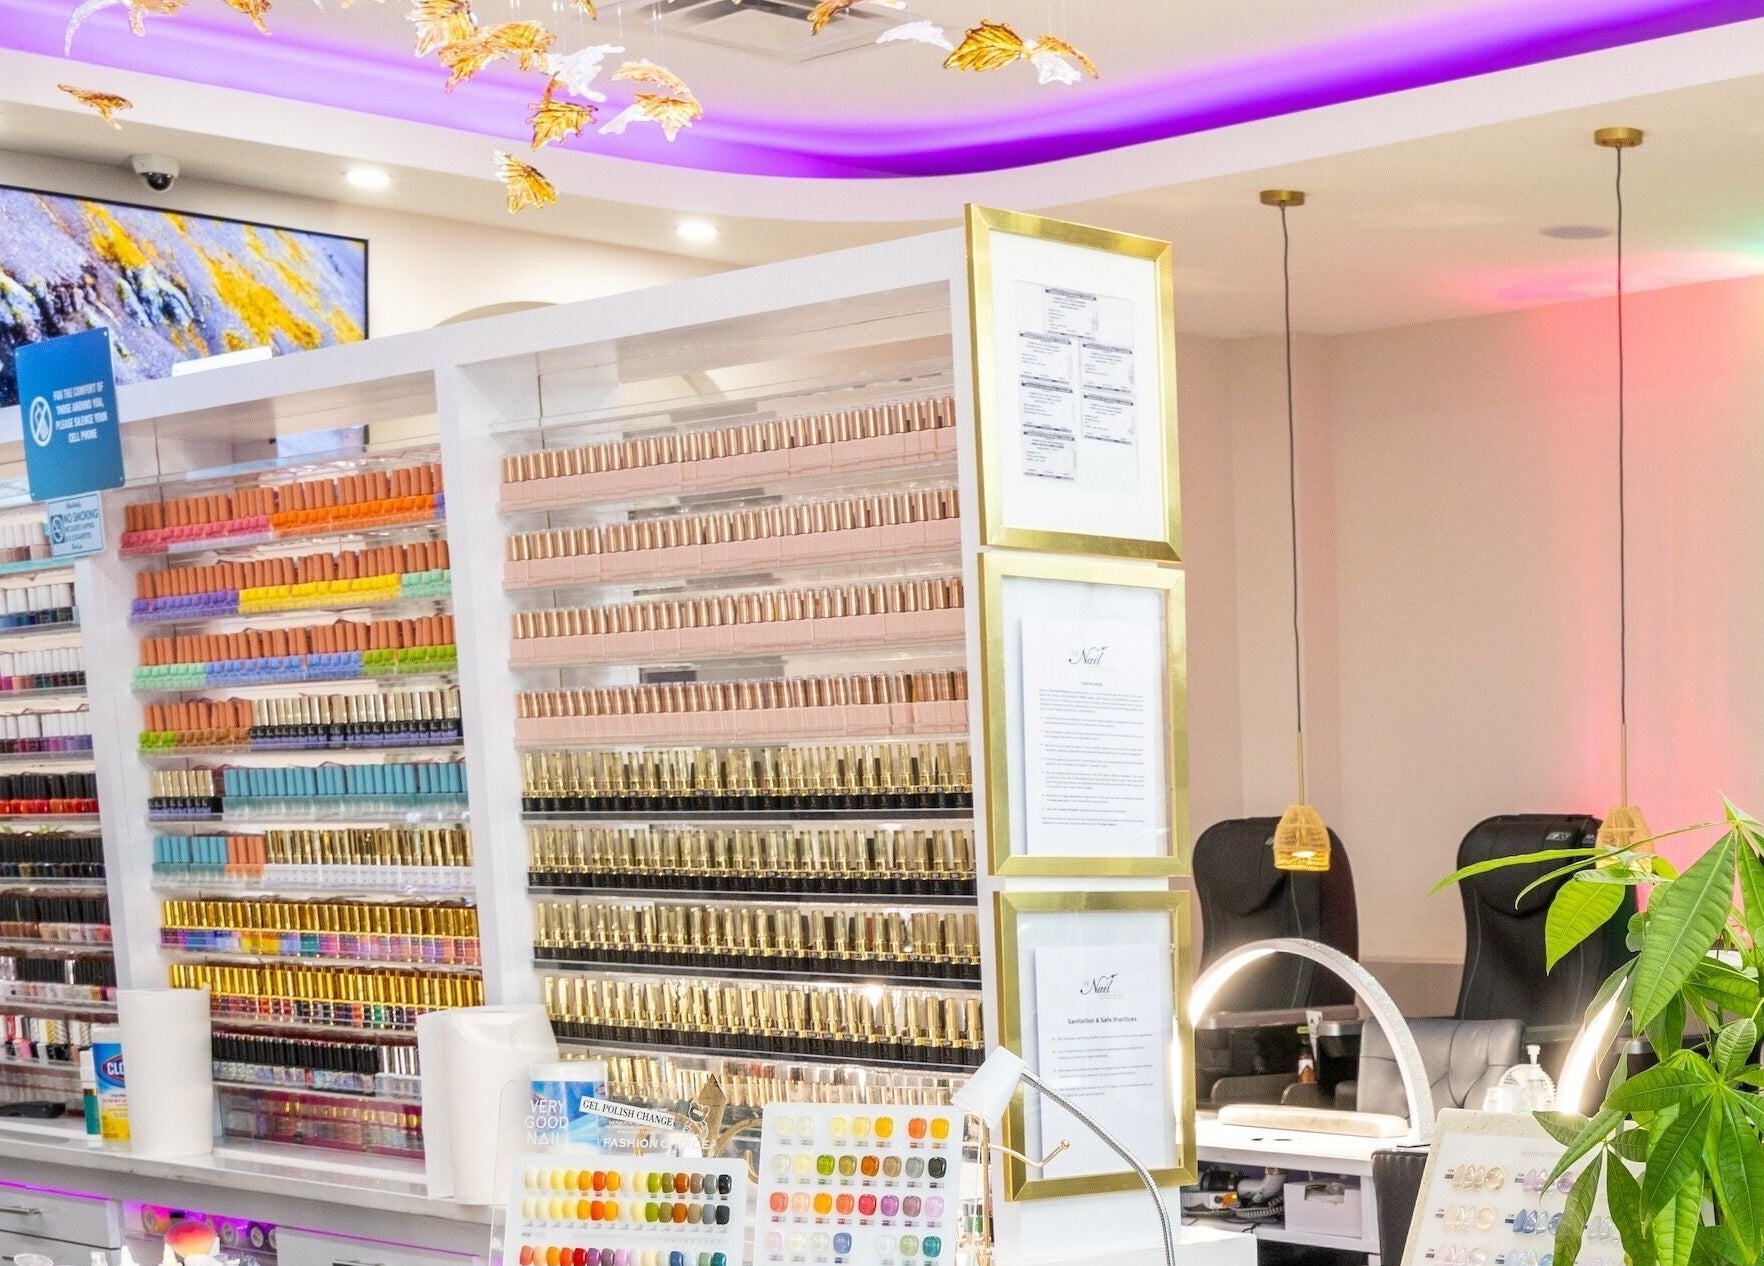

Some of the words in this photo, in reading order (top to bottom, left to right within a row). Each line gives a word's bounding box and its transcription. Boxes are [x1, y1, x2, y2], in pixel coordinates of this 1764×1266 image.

[1069, 646, 1106, 665] Nail
[1080, 975, 1115, 995] Nail
[530, 1099, 566, 1114] VERY
[582, 1099, 600, 1111] GEL
[602, 1103, 635, 1119] POLISH
[636, 1111, 673, 1127] CHANGE
[524, 1115, 570, 1129] GOOD
[603, 1137, 658, 1149] FASHION
